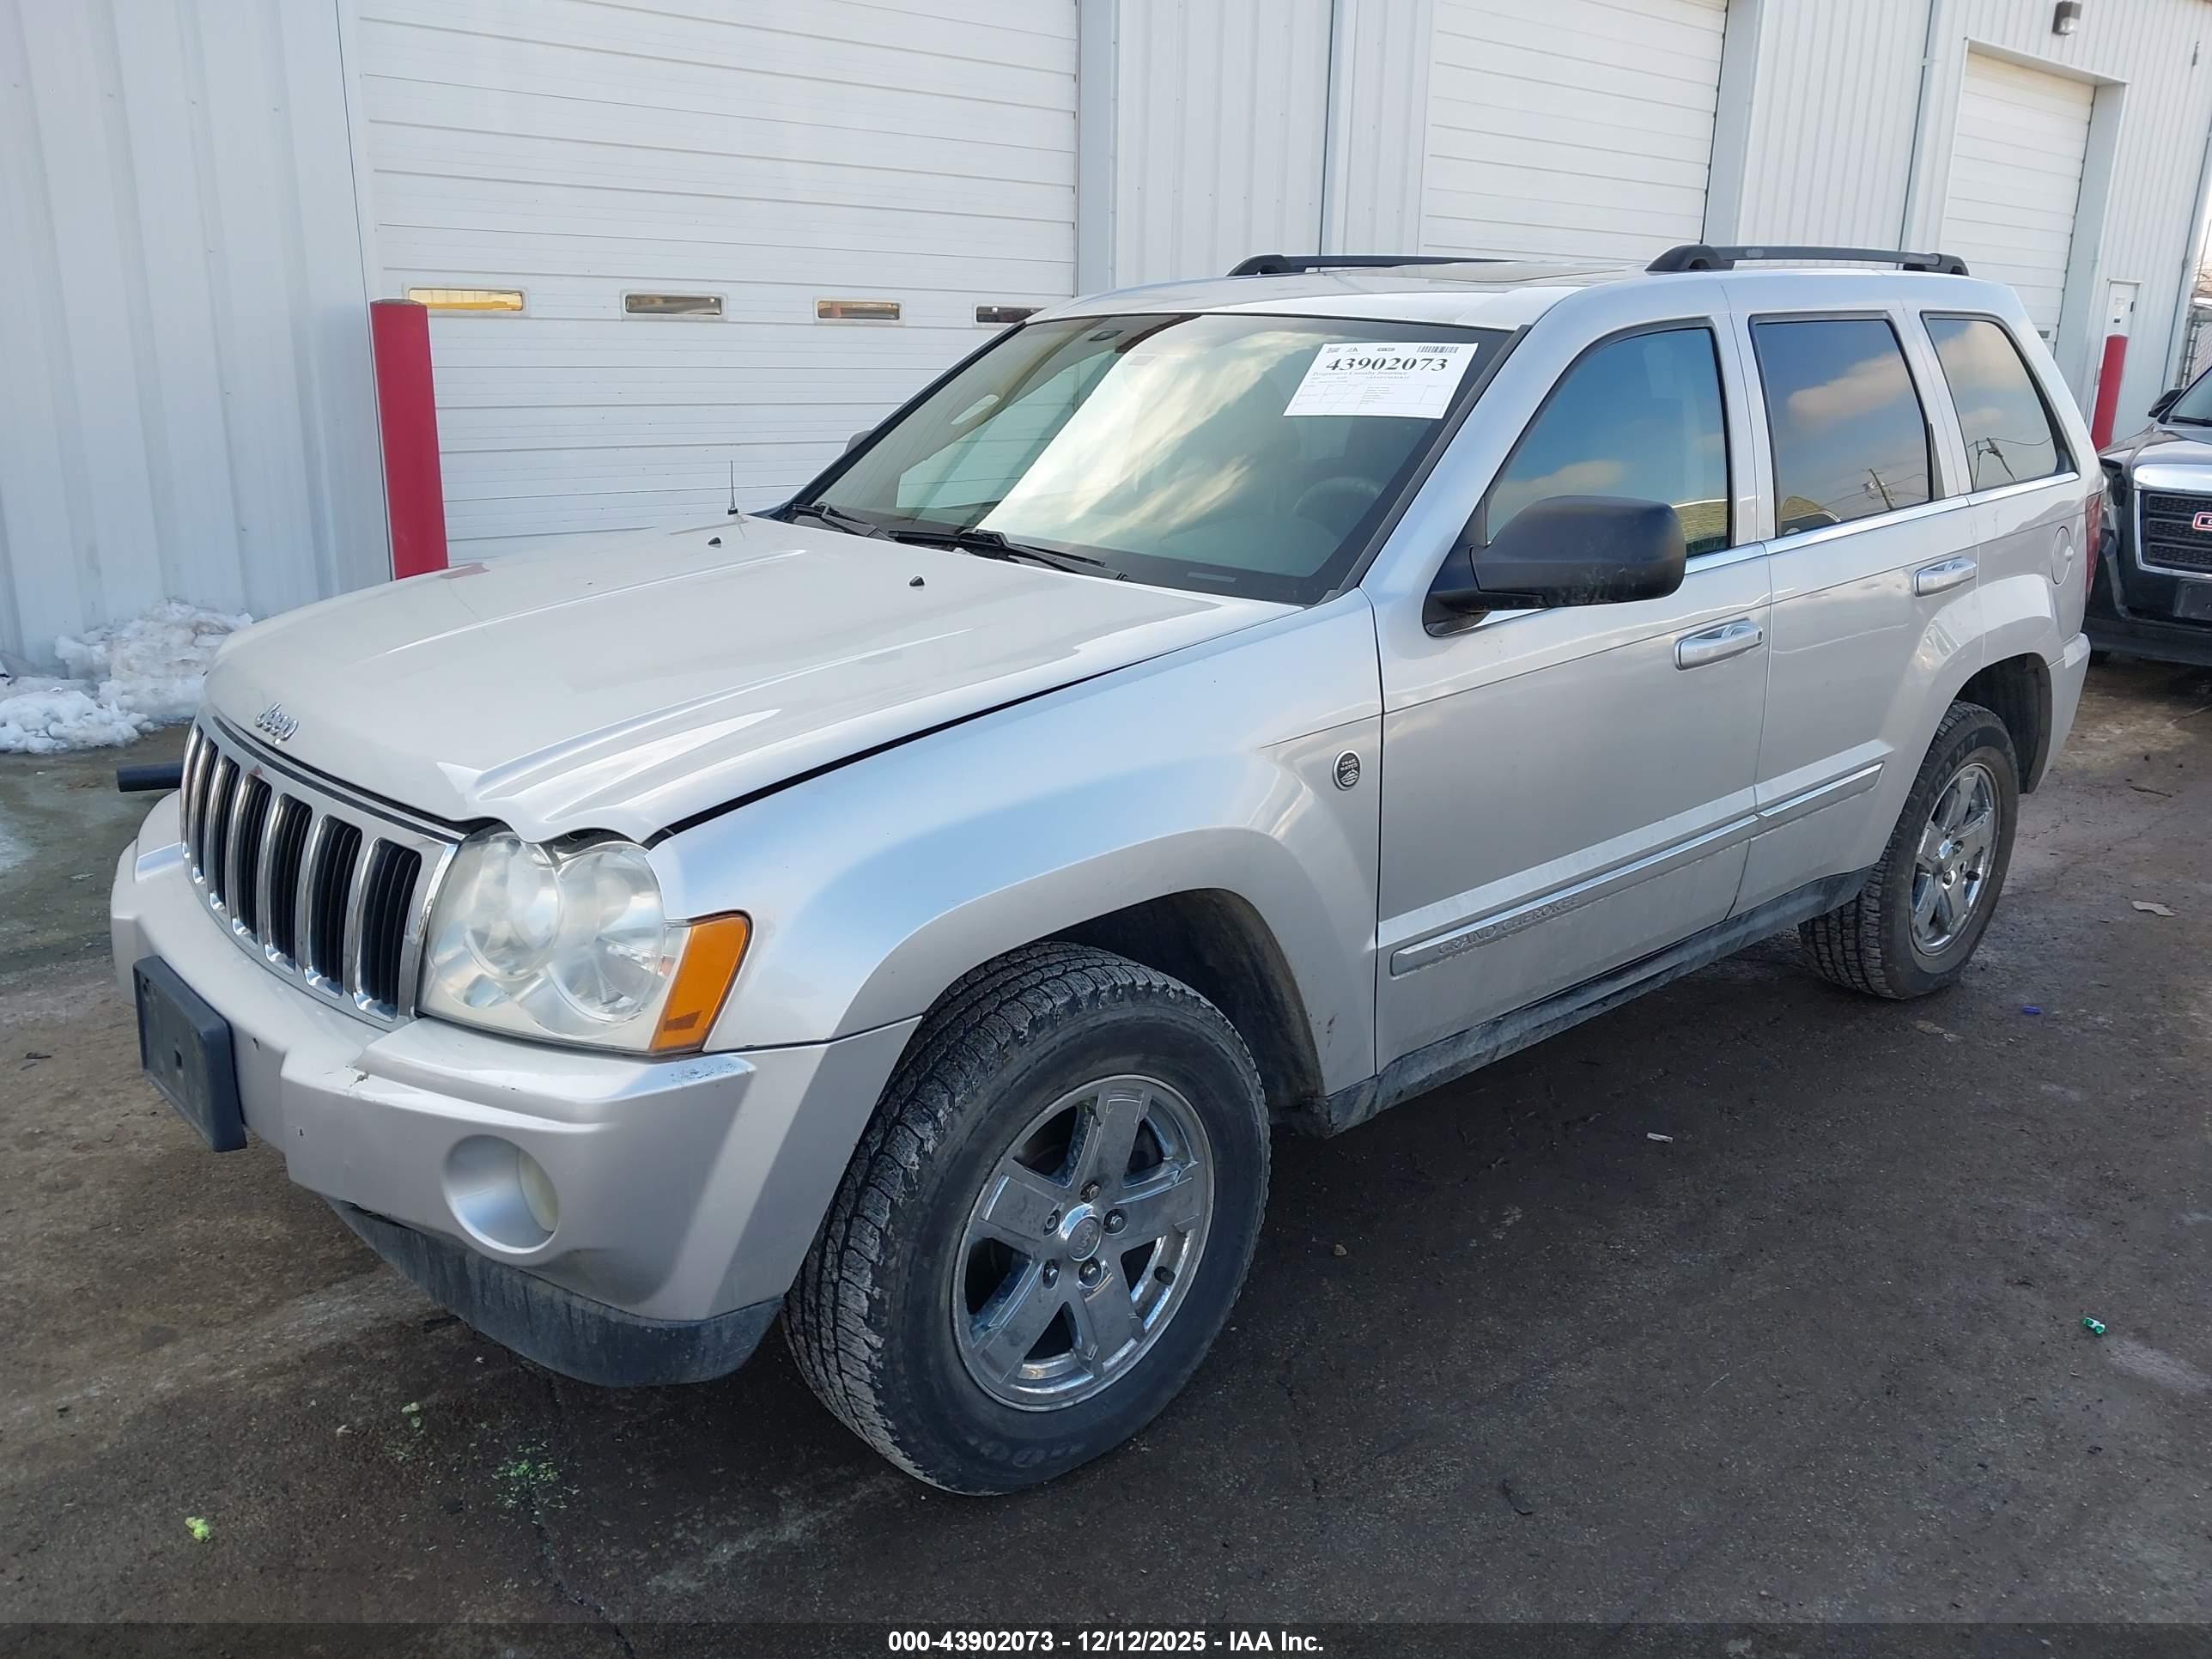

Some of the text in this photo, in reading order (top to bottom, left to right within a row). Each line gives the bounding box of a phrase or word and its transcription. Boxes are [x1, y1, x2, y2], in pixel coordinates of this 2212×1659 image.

[1325, 357, 1449, 371] 43902073
[254, 702, 299, 745] Jeep
[1439, 894, 1580, 954] GRAND CHEROKEE
